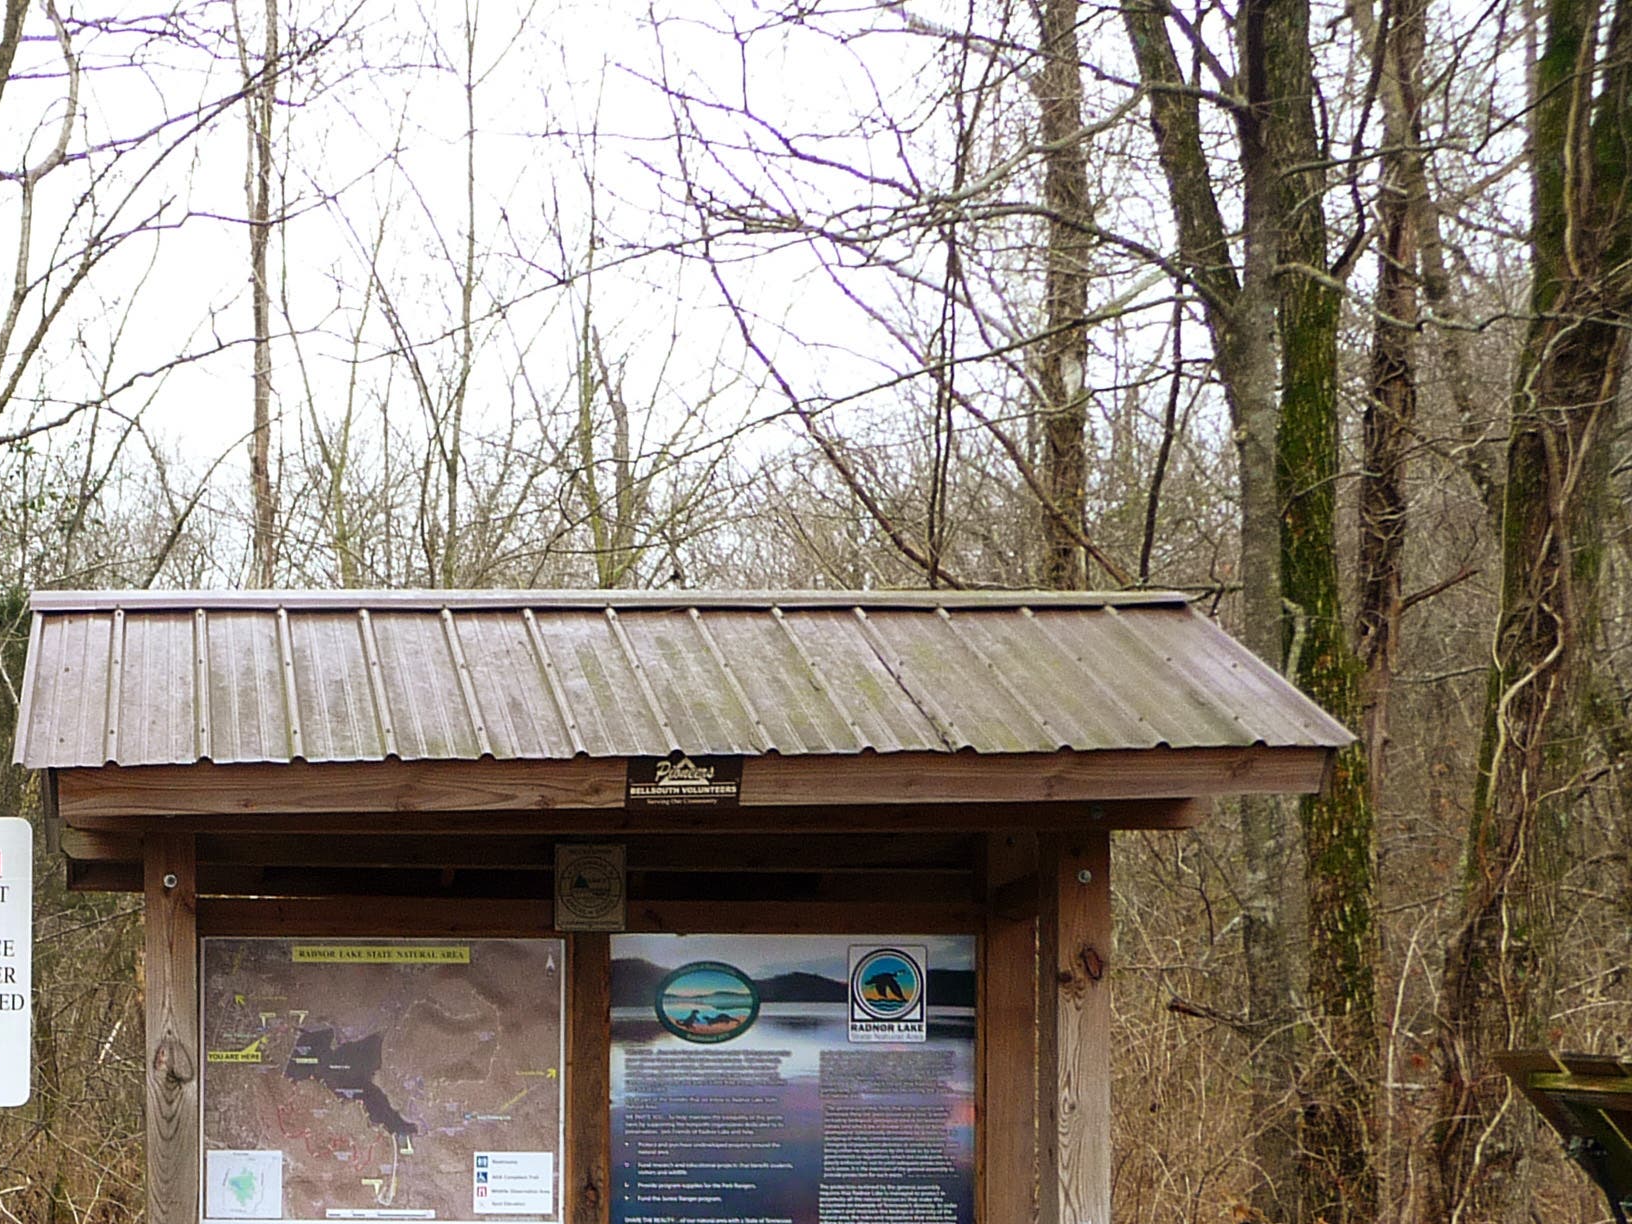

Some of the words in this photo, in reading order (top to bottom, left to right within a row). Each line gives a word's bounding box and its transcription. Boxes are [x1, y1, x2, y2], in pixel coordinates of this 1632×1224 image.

[630, 786, 680, 795] BELLSOUTH
[681, 786, 737, 794] VOLUNTEERS
[851, 1024, 894, 1032] RADNOR
[898, 1023, 924, 1032] LAKE
